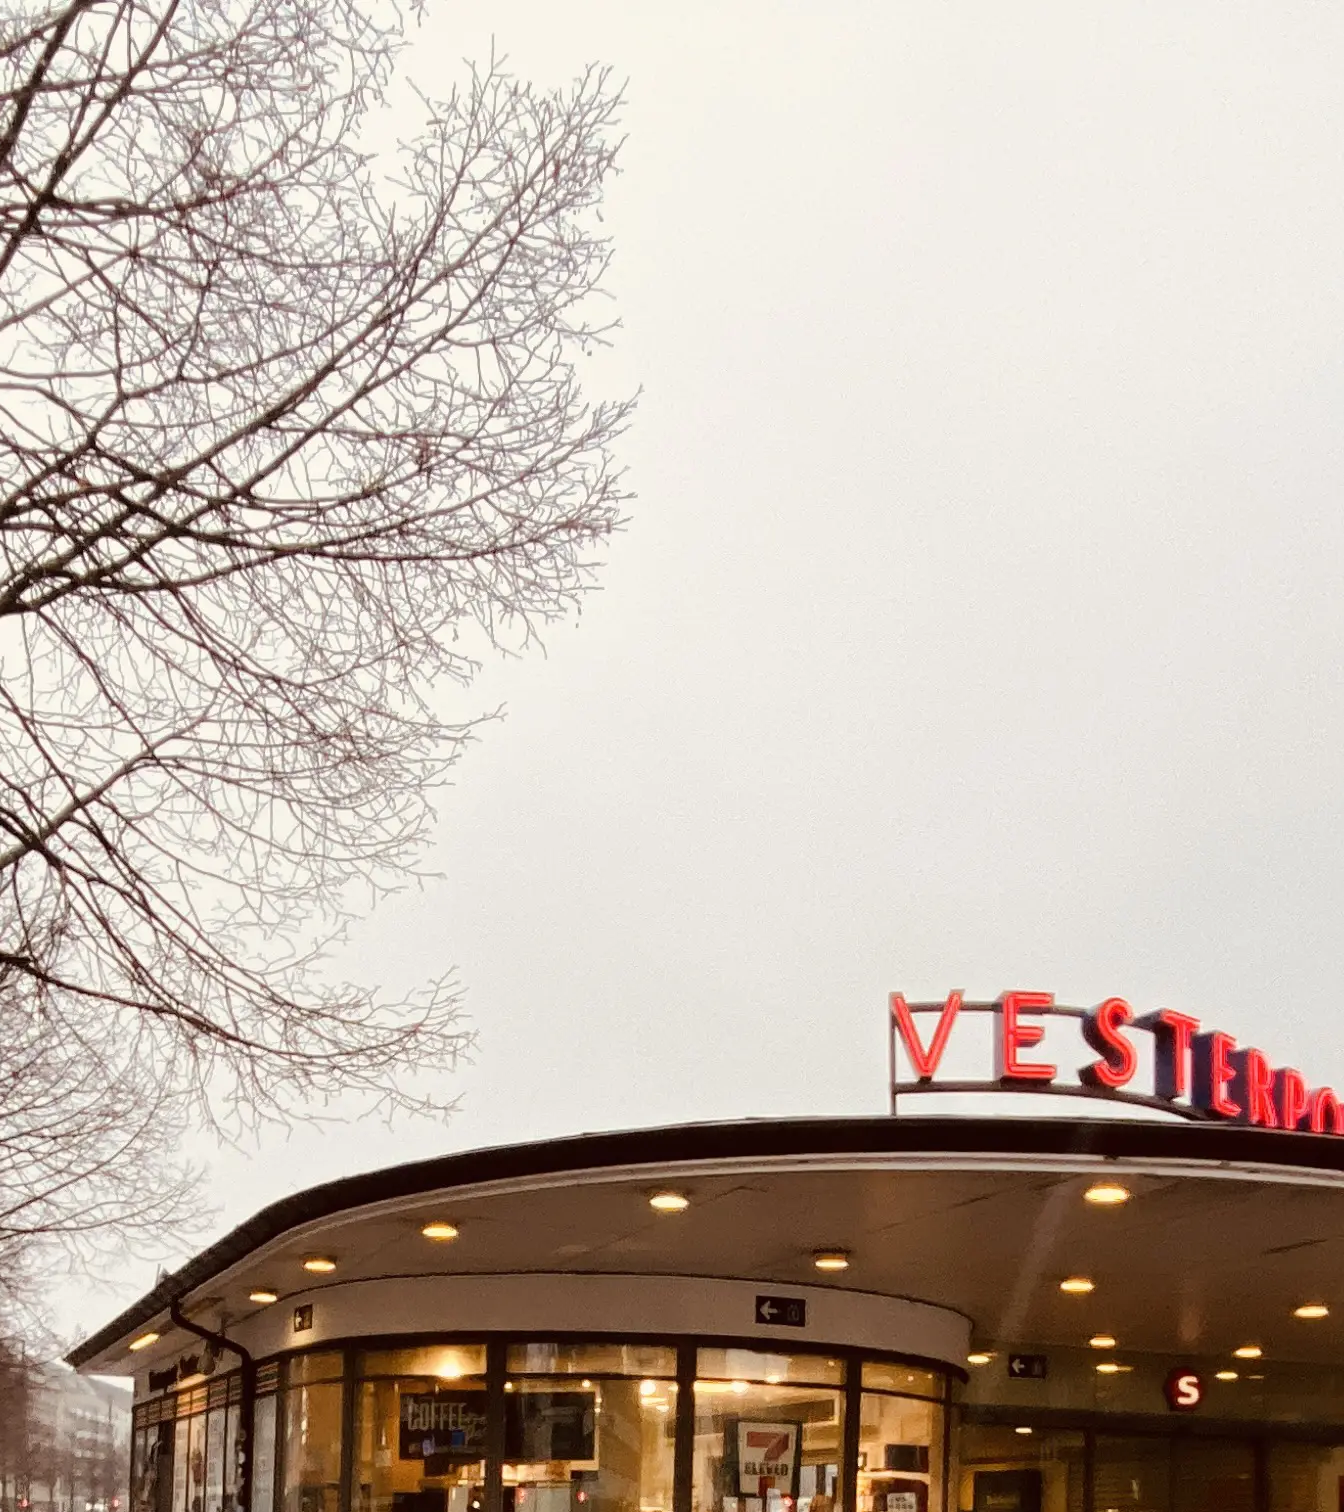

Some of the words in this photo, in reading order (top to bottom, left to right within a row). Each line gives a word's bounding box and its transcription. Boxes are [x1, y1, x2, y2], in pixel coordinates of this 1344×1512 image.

[1177, 1375, 1200, 1405] S
[407, 1401, 467, 1431] COFFEE
[746, 1431, 790, 1484] 7
